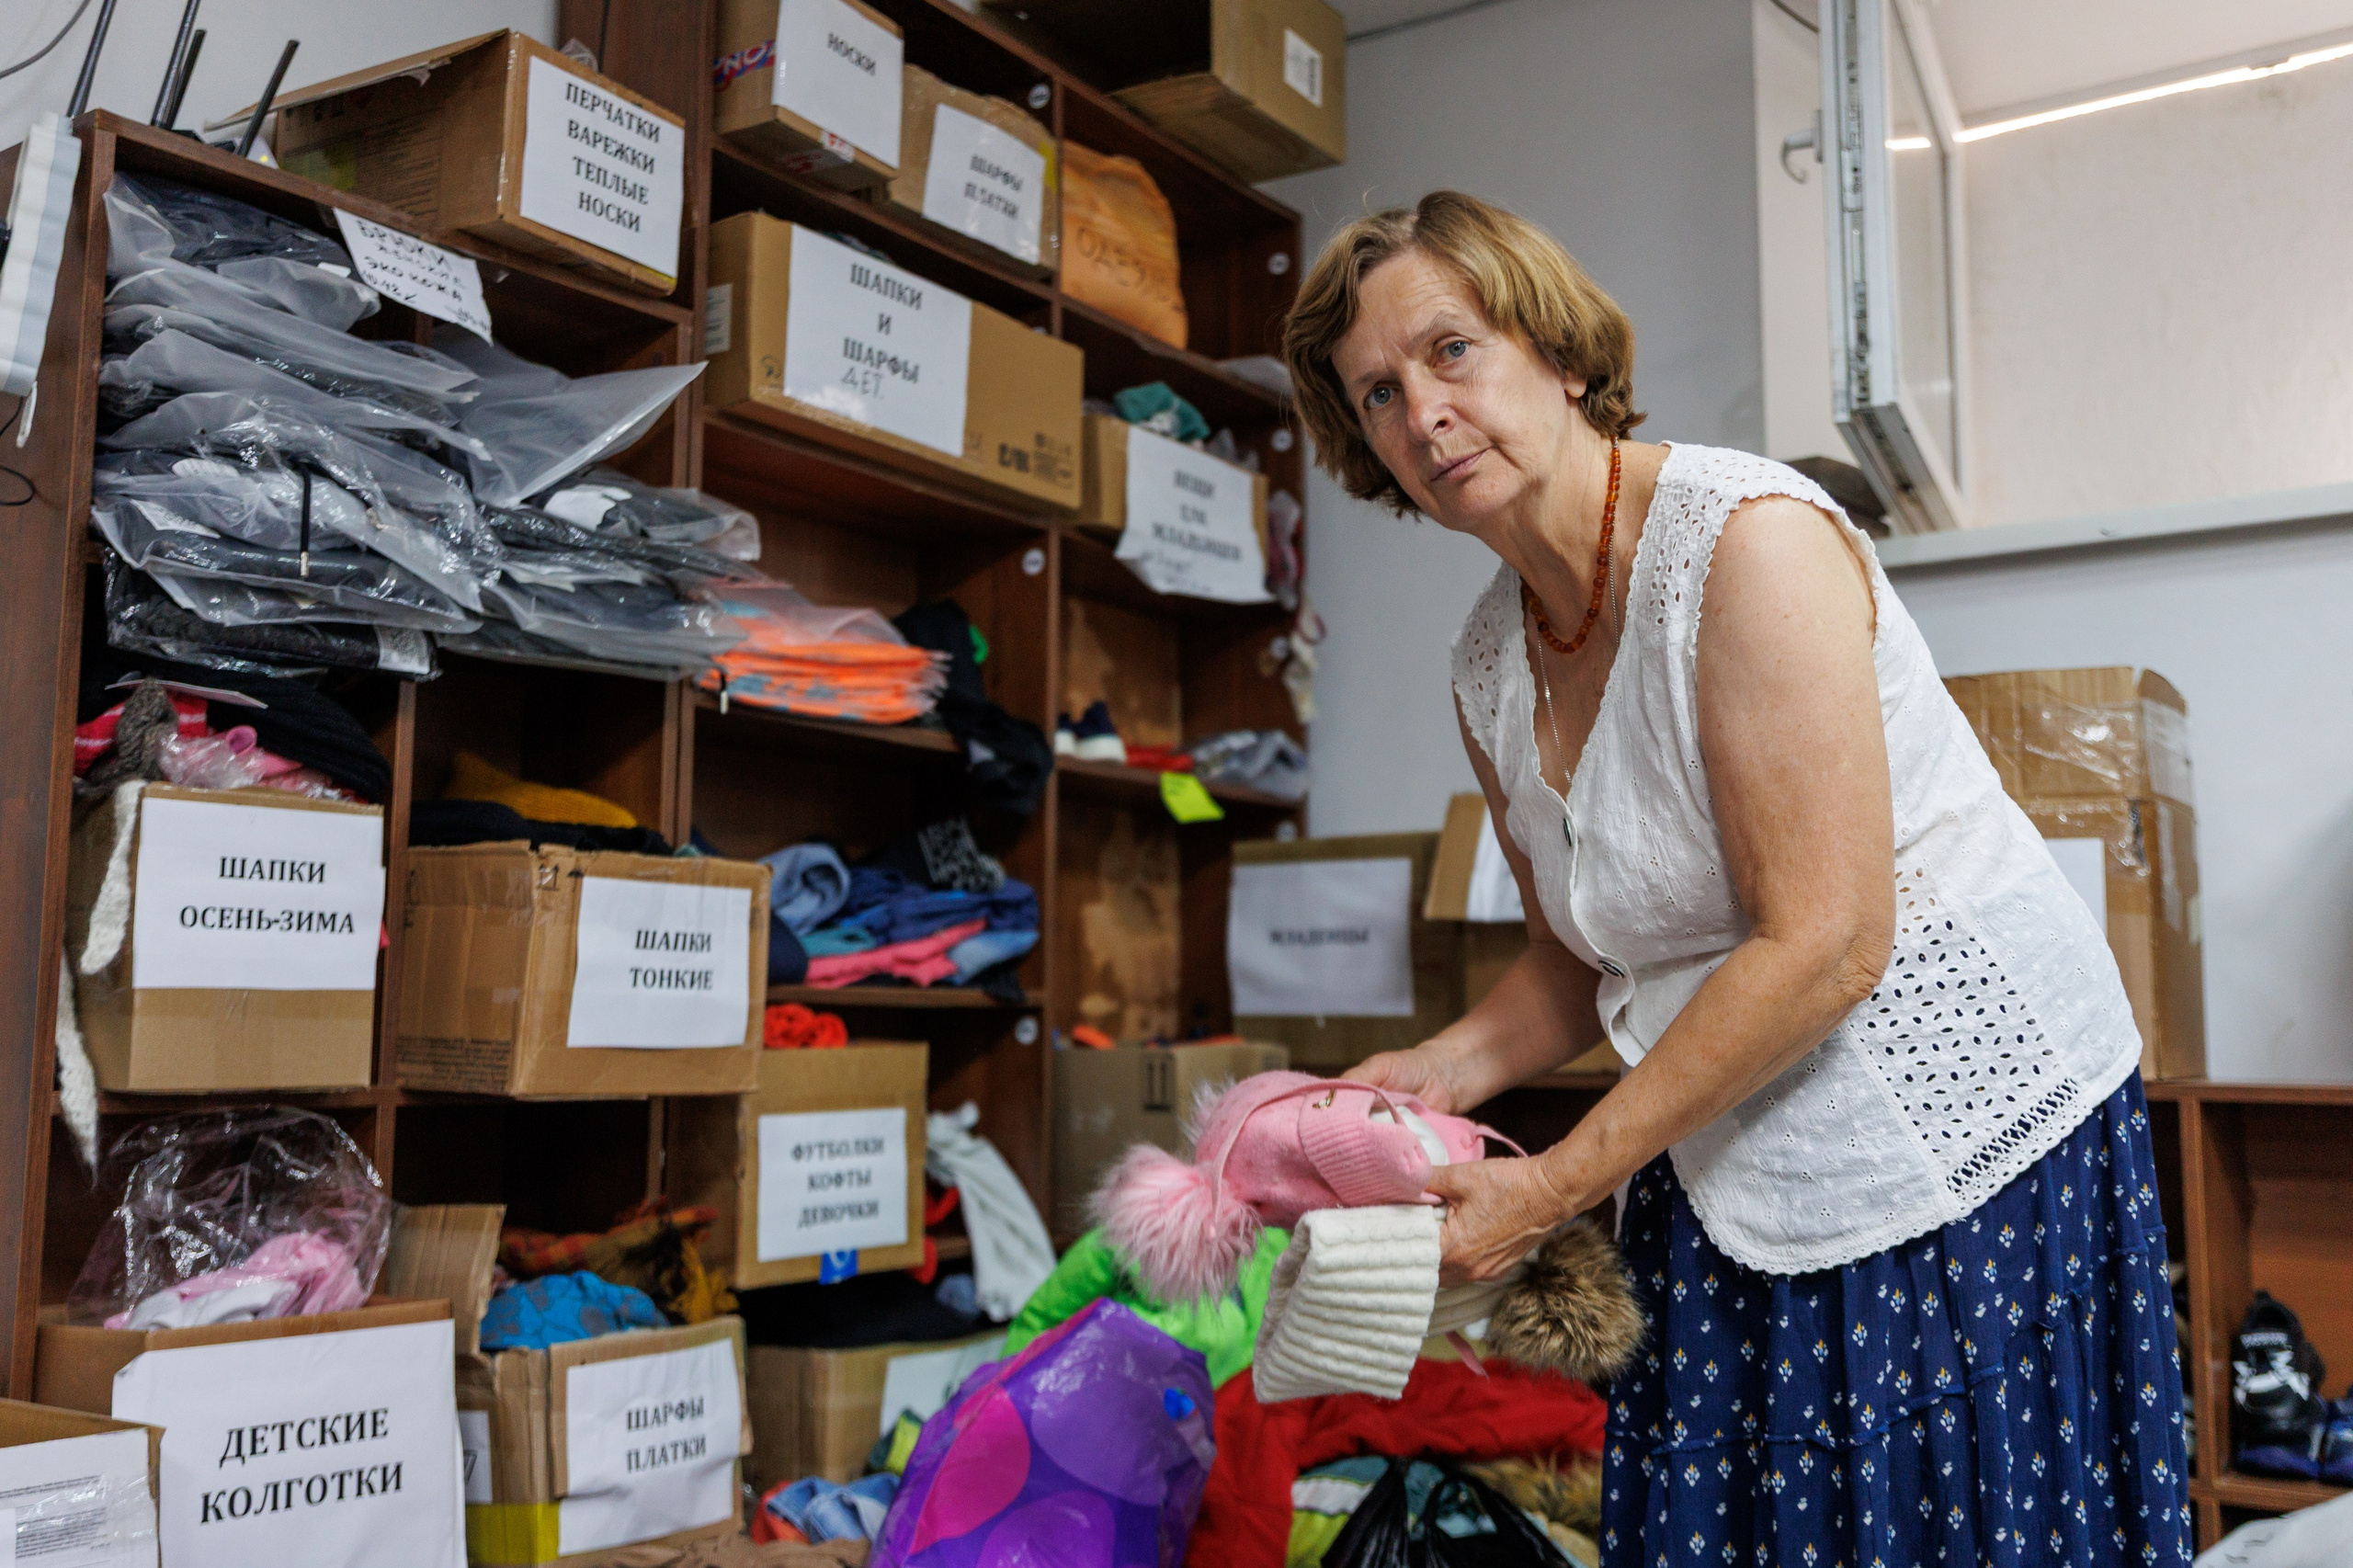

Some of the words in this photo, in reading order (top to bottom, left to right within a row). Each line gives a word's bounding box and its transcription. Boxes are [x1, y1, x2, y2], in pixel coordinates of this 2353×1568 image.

[827, 31, 876, 76] НОСКИ
[565, 82, 661, 142] ПЕРЧАТКИ
[567, 119, 655, 175] ВАРЕЖКИ
[573, 155, 649, 205] ТЕПЛЫЕ
[970, 154, 1023, 192] ШАРФЫ
[577, 190, 641, 233] НОСКИ
[964, 182, 1020, 220] ПЛАТКИ
[849, 262, 923, 311] ШАПКИ
[878, 312, 892, 335] И
[843, 336, 919, 384] ШАРФЫ
[219, 856, 326, 884] ШАПКИ
[179, 905, 356, 935] ОСЕНЬ-ЗИМА
[634, 929, 711, 953] ШАПКИ
[630, 967, 713, 991] ТОНКИЕ
[790, 1137, 884, 1162] ФУТБОЛКИ
[808, 1167, 871, 1192] КОФТЫ
[797, 1199, 880, 1230] ДЕВОЧКИ
[627, 1395, 704, 1431] ШАРФЫ
[219, 1407, 389, 1470] ДЕТСКИЕ
[627, 1435, 706, 1473] ПЛАТКИ
[200, 1461, 404, 1526] КОЛГОТКИ
